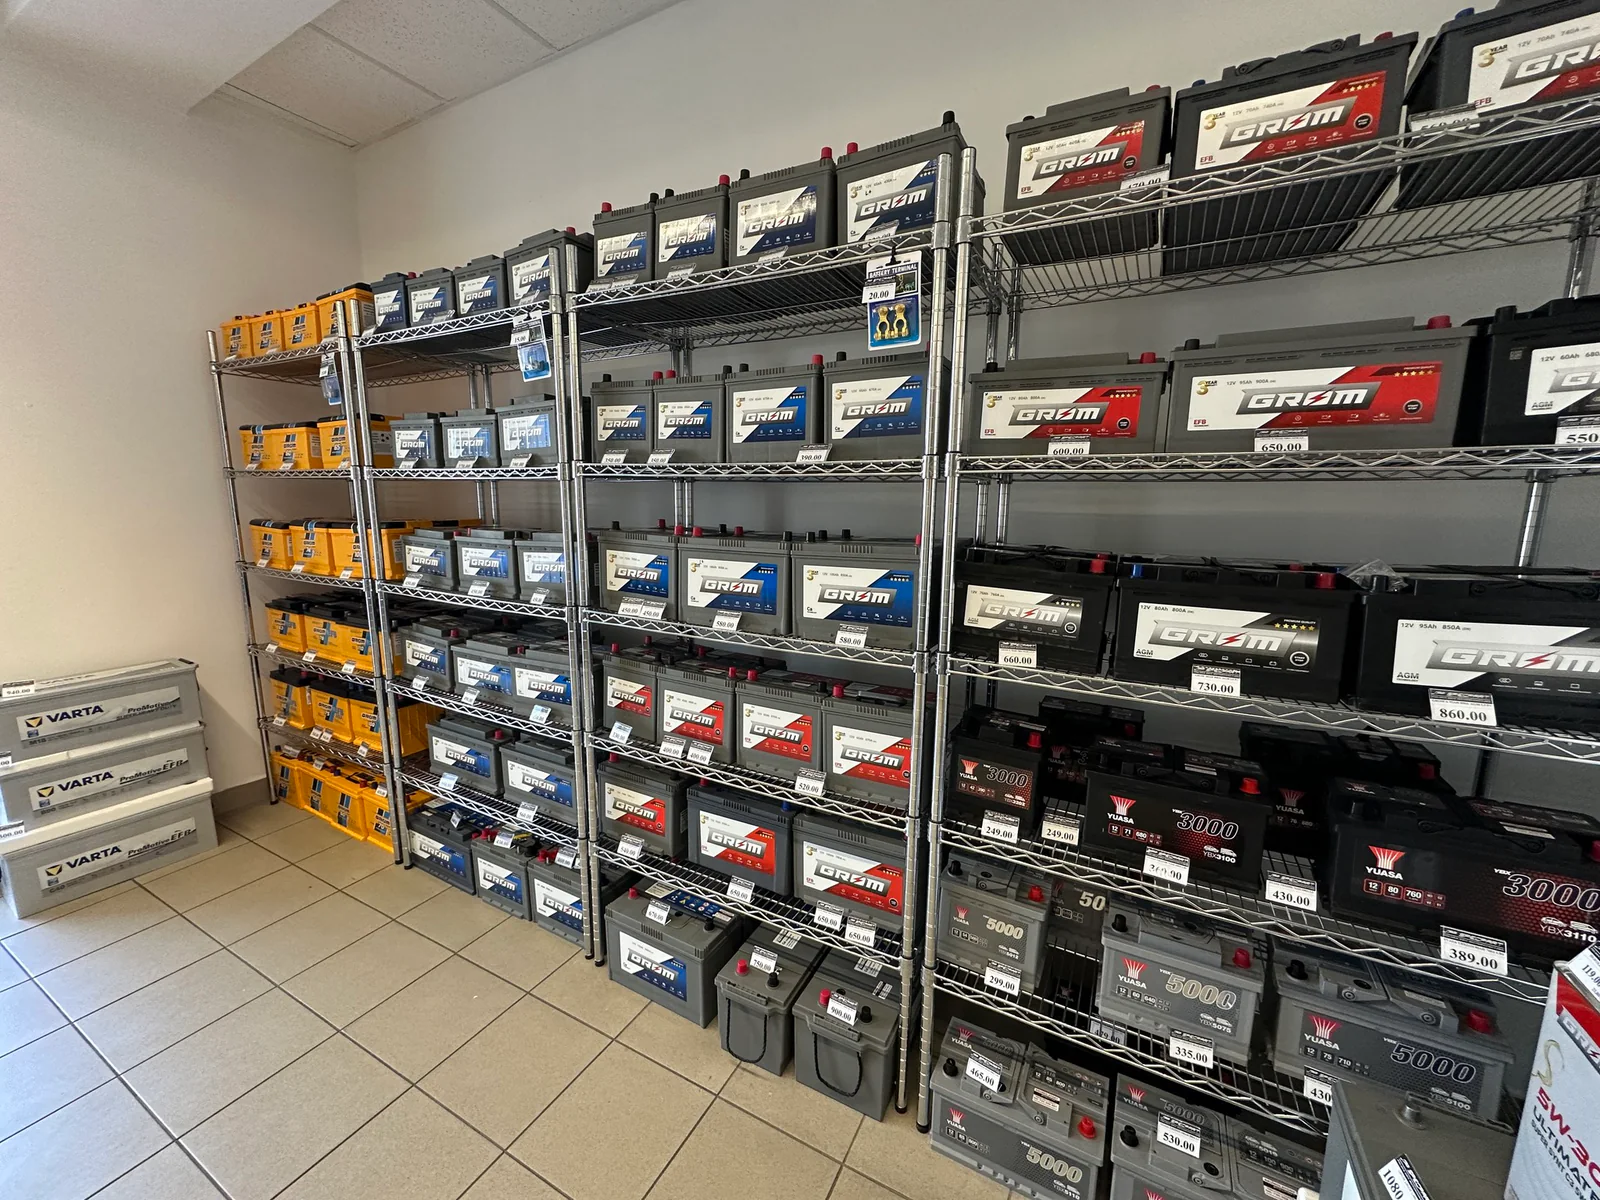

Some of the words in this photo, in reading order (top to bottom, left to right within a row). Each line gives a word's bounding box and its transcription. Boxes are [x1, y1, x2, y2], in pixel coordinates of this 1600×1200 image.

[1478, 48, 1495, 68] 3
[1490, 44, 1508, 52] YEAR
[1230, 105, 1345, 143] GROM
[1039, 147, 1120, 175] GROM
[860, 190, 926, 217] GROM
[748, 211, 805, 234] GROM
[869, 290, 889, 300] 20.00
[1196, 380, 1208, 395] 3
[1247, 388, 1368, 409] GROM
[744, 410, 794, 424] GROM
[843, 400, 906, 418] GROM
[1016, 407, 1101, 421] GROM
[602, 418, 639, 429] GROM
[665, 416, 704, 426] GROM
[1053, 448, 1084, 456] 600.00
[1262, 443, 1302, 452] 650.00
[617, 566, 658, 582] GROM
[704, 578, 759, 594] GROM
[823, 588, 890, 604] GROM
[984, 604, 1061, 622] GROM
[839, 636, 861, 646] 580.00
[1160, 626, 1283, 652] GROM
[1004, 656, 1032, 664] 660.00
[1136, 648, 1154, 656] AGM
[1440, 647, 1600, 674] GROM
[1397, 672, 1420, 680] AGM
[1198, 682, 1234, 694] 730.00
[613, 690, 646, 704] GROM
[46, 705, 104, 723] VARTA
[128, 701, 170, 714] ProMotive
[672, 709, 715, 728] GROM
[1440, 708, 1487, 722] 860.00
[752, 724, 802, 743] GROM
[843, 748, 902, 767] GROM
[58, 772, 114, 792] VARTA
[120, 768, 162, 783] ProMotive
[162, 759, 184, 771] EFB
[960, 772, 978, 781] YUASA
[987, 766, 1028, 788] 3000
[798, 783, 819, 794] 520.00
[615, 800, 655, 820] GROM
[1276, 804, 1304, 815] YUASA
[1107, 812, 1134, 824] YUASA
[1177, 812, 1239, 840] 3000
[986, 826, 1012, 839] 249.00
[1047, 828, 1074, 841] 249.00
[66, 846, 122, 869] VARTA
[128, 838, 170, 856] ProMotive
[170, 828, 192, 842] EFB
[710, 831, 765, 857] GROM
[1204, 851, 1236, 864] YBX3100
[819, 864, 886, 893] GROM
[1366, 866, 1404, 880] YUASA
[1494, 868, 1512, 876] YBX
[1272, 890, 1310, 907] 430.00
[1368, 882, 1378, 890] 12
[1388, 886, 1399, 894] 80
[1406, 889, 1422, 899] 760
[1502, 874, 1600, 912] 3000
[818, 916, 838, 928] 650.00
[953, 916, 970, 926] YUASA
[986, 918, 1024, 940] 5000
[848, 932, 871, 944] 650.00
[1540, 923, 1598, 943] YBX3110
[630, 954, 677, 981] GROM
[754, 959, 772, 972] 750.00
[1449, 948, 1499, 971] 389.00
[990, 976, 1015, 991] 299.00
[1118, 974, 1147, 990] YUASA
[1166, 973, 1236, 1010] 5000
[831, 1007, 852, 1022] 900.00
[1200, 1018, 1232, 1034] YBX5075
[951, 1036, 973, 1050] YUASA
[1304, 1033, 1340, 1051] YUASA
[1175, 1046, 1208, 1064] 335.00
[1338, 1057, 1352, 1066] 710
[1390, 1042, 1476, 1084] 5000
[970, 1067, 995, 1087] 465.00
[1124, 1098, 1149, 1112] YUASA
[1164, 1101, 1205, 1126] 5000
[946, 1118, 966, 1132] YUASA
[1530, 1119, 1548, 1149] SUPER
[1162, 1132, 1196, 1153] 530.00
[1026, 1146, 1082, 1184] 5000
